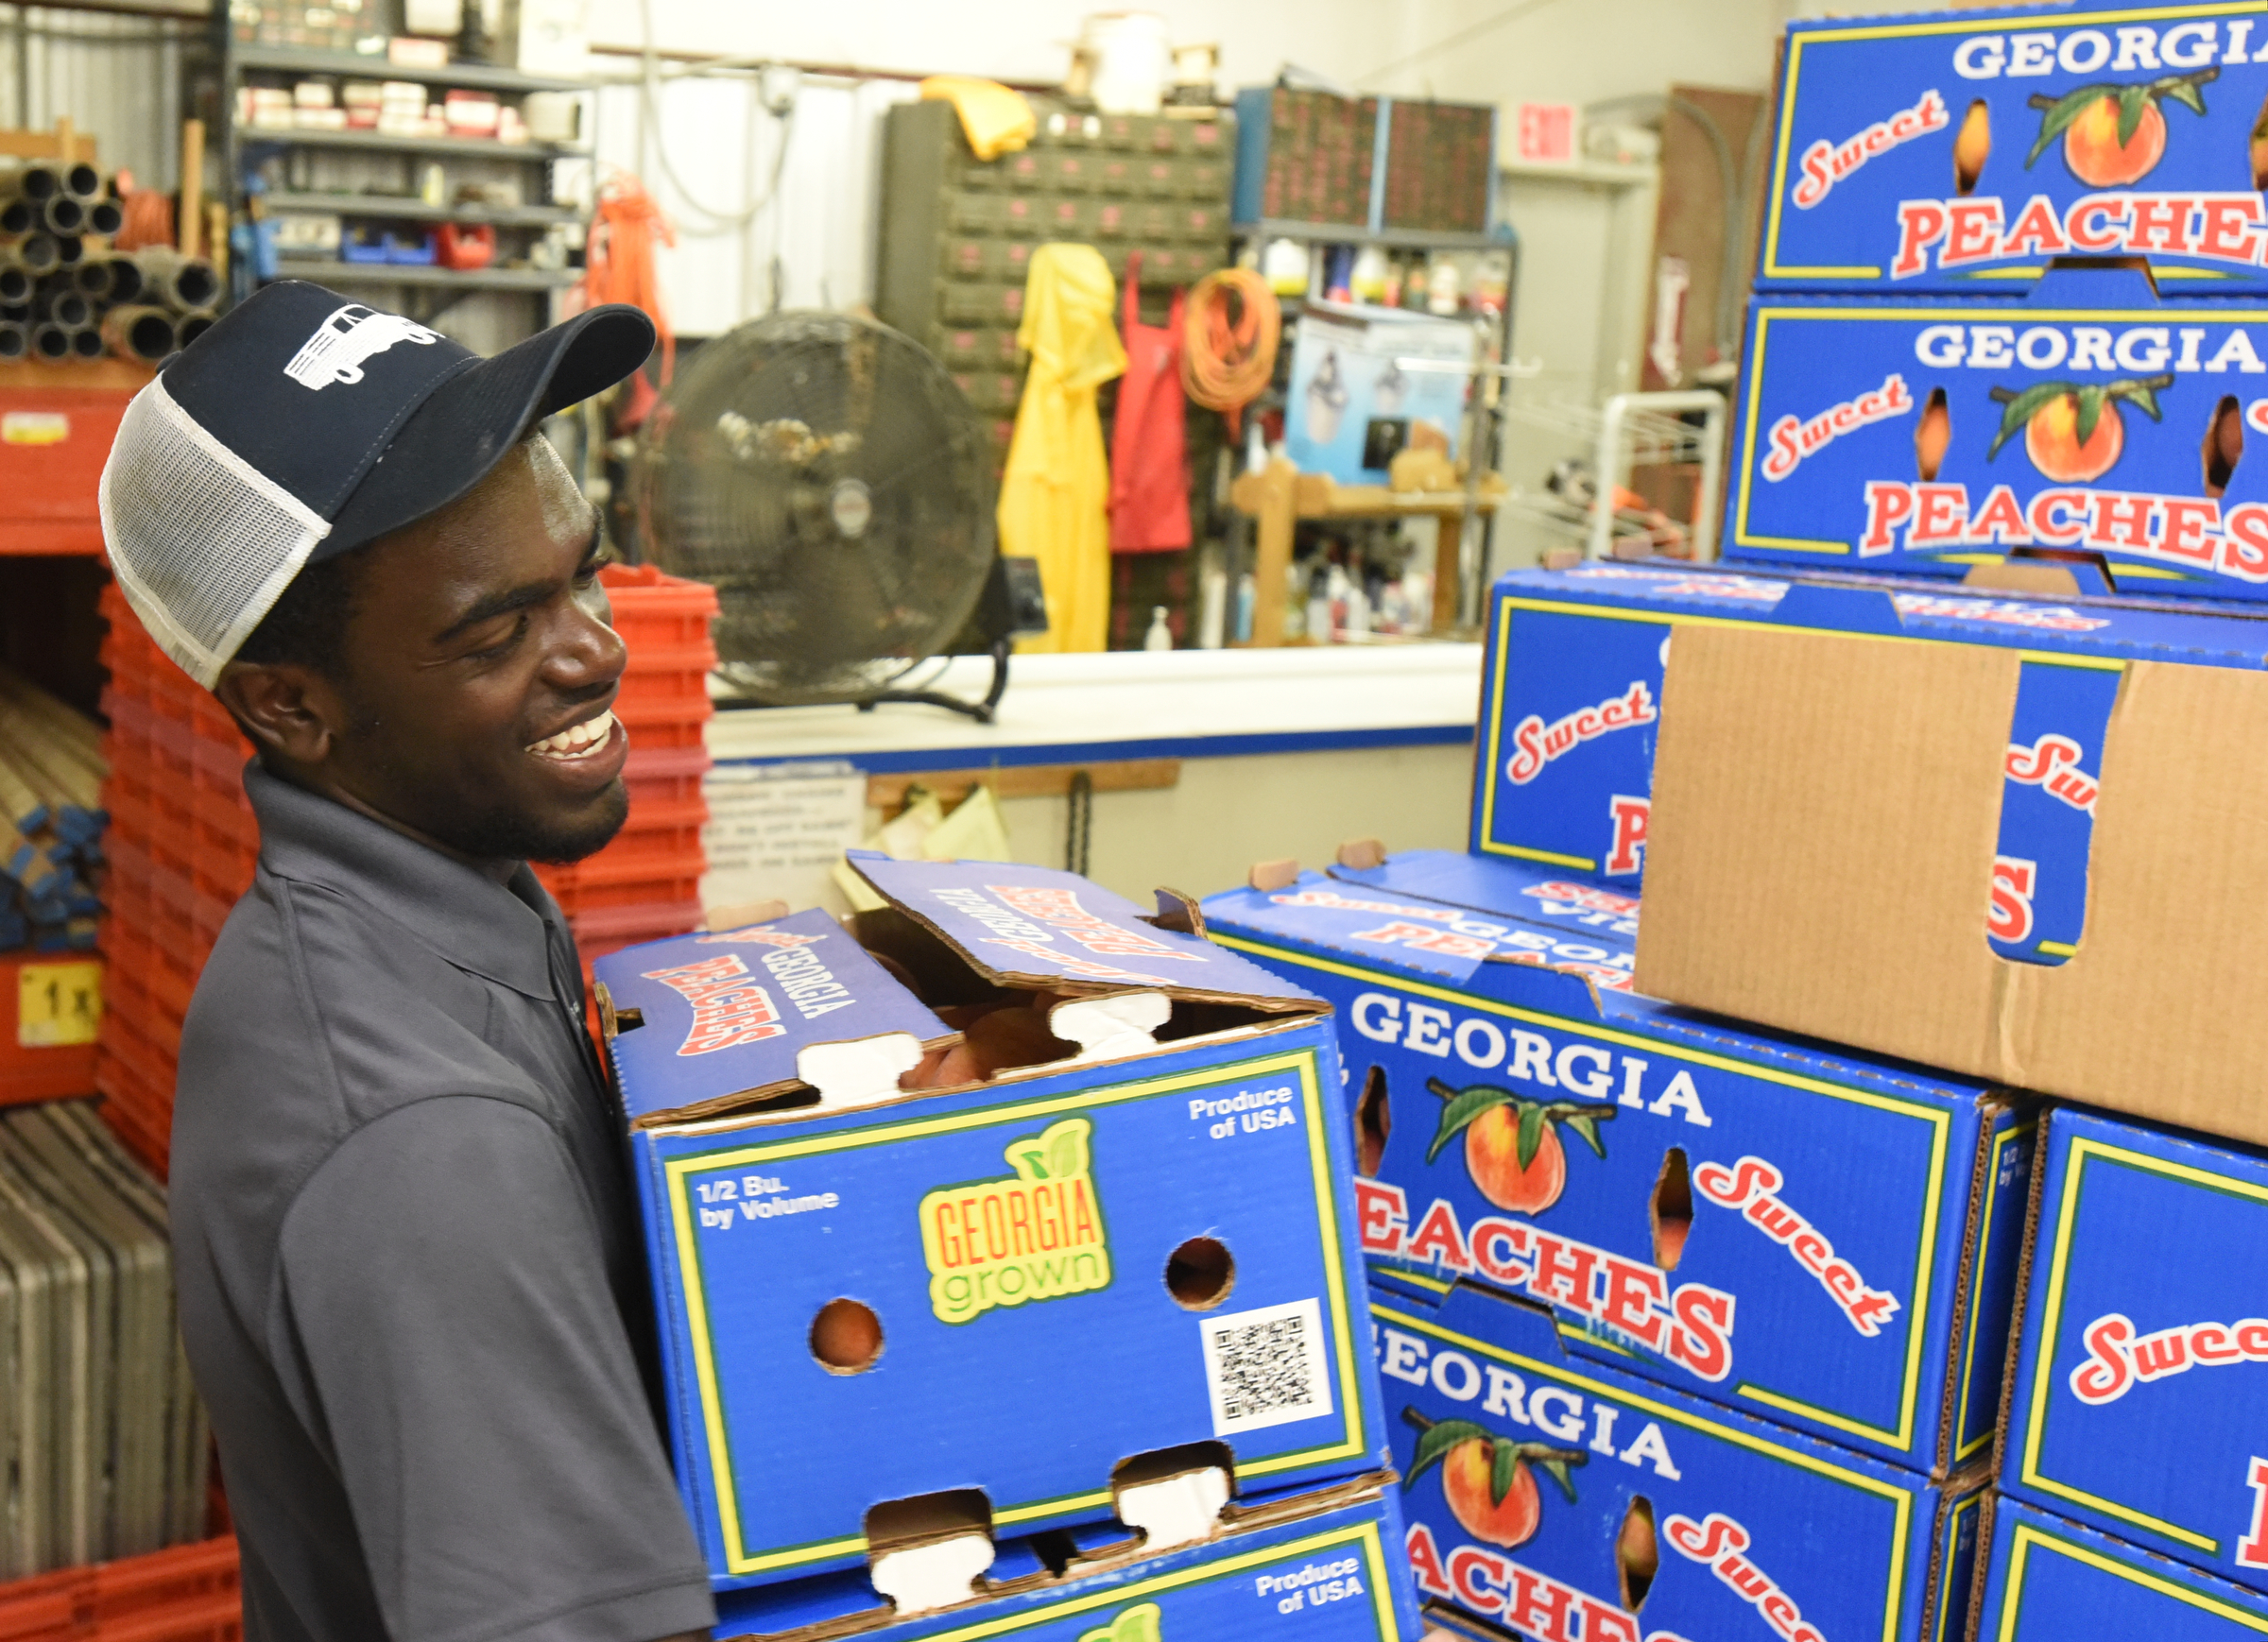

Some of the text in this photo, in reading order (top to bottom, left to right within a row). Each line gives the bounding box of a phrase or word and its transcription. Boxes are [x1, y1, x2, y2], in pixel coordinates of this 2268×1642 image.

[1952, 20, 2268, 79] GEORGI
[1793, 90, 1949, 210] Sweet
[1891, 192, 2268, 280] PEACHE
[1915, 325, 2265, 372] GEORGIA
[1763, 374, 1911, 481] Sweet
[1859, 480, 2268, 582] PEACHES
[1506, 679, 1657, 786] Sweet
[640, 953, 787, 1056] PEACHES
[761, 946, 856, 1019] GEORGIA
[1351, 992, 1712, 1128] GEORGIA
[1188, 1086, 1293, 1120] Produce
[1210, 1105, 1297, 1139] of USA
[696, 1175, 790, 1203] 1/2 Bu.
[698, 1192, 840, 1230] by Volume
[936, 1179, 1095, 1268] GEORGIA
[945, 1253, 1100, 1312] grown
[1692, 1155, 1901, 1337] Sweet
[1372, 1325, 1680, 1481] EORGIA
[1255, 1557, 1359, 1598] Produce
[1277, 1576, 1364, 1615] of USA
